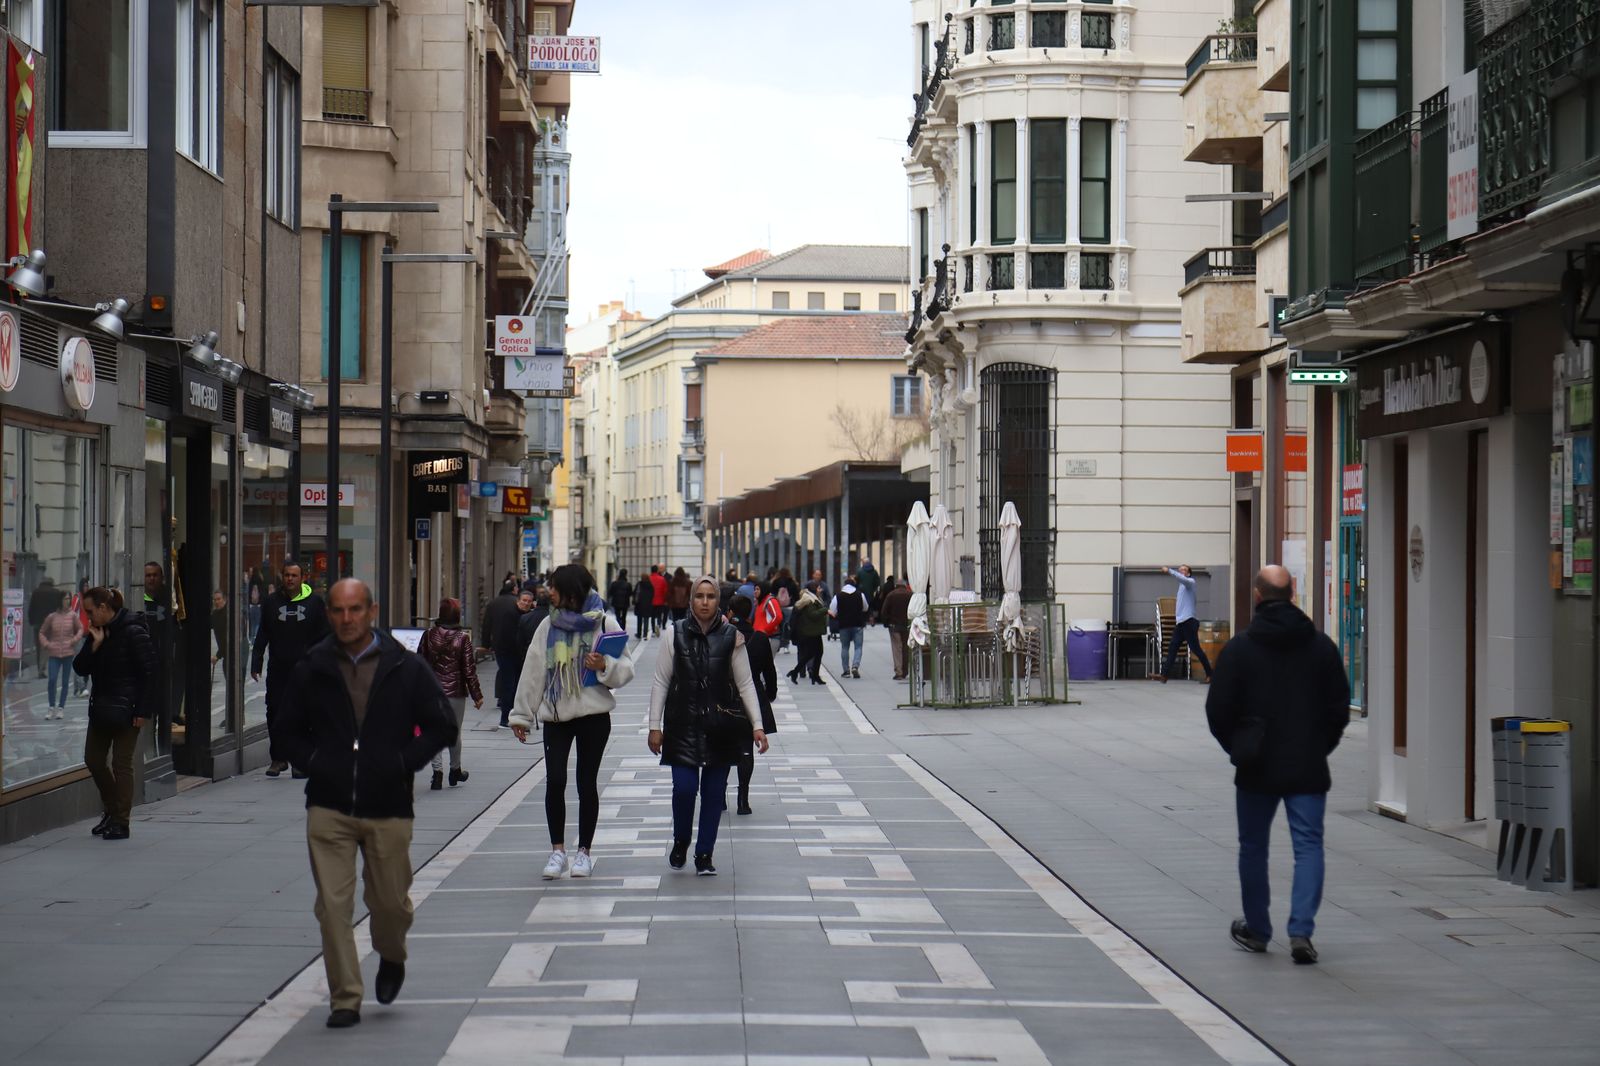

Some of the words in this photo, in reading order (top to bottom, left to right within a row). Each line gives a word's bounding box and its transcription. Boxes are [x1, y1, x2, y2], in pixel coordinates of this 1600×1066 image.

[565, 38, 584, 46] JOSE
[530, 46, 597, 61] PODOLOGO
[499, 337, 532, 345] General
[427, 484, 448, 493] BAR
[304, 488, 344, 503] Opta
